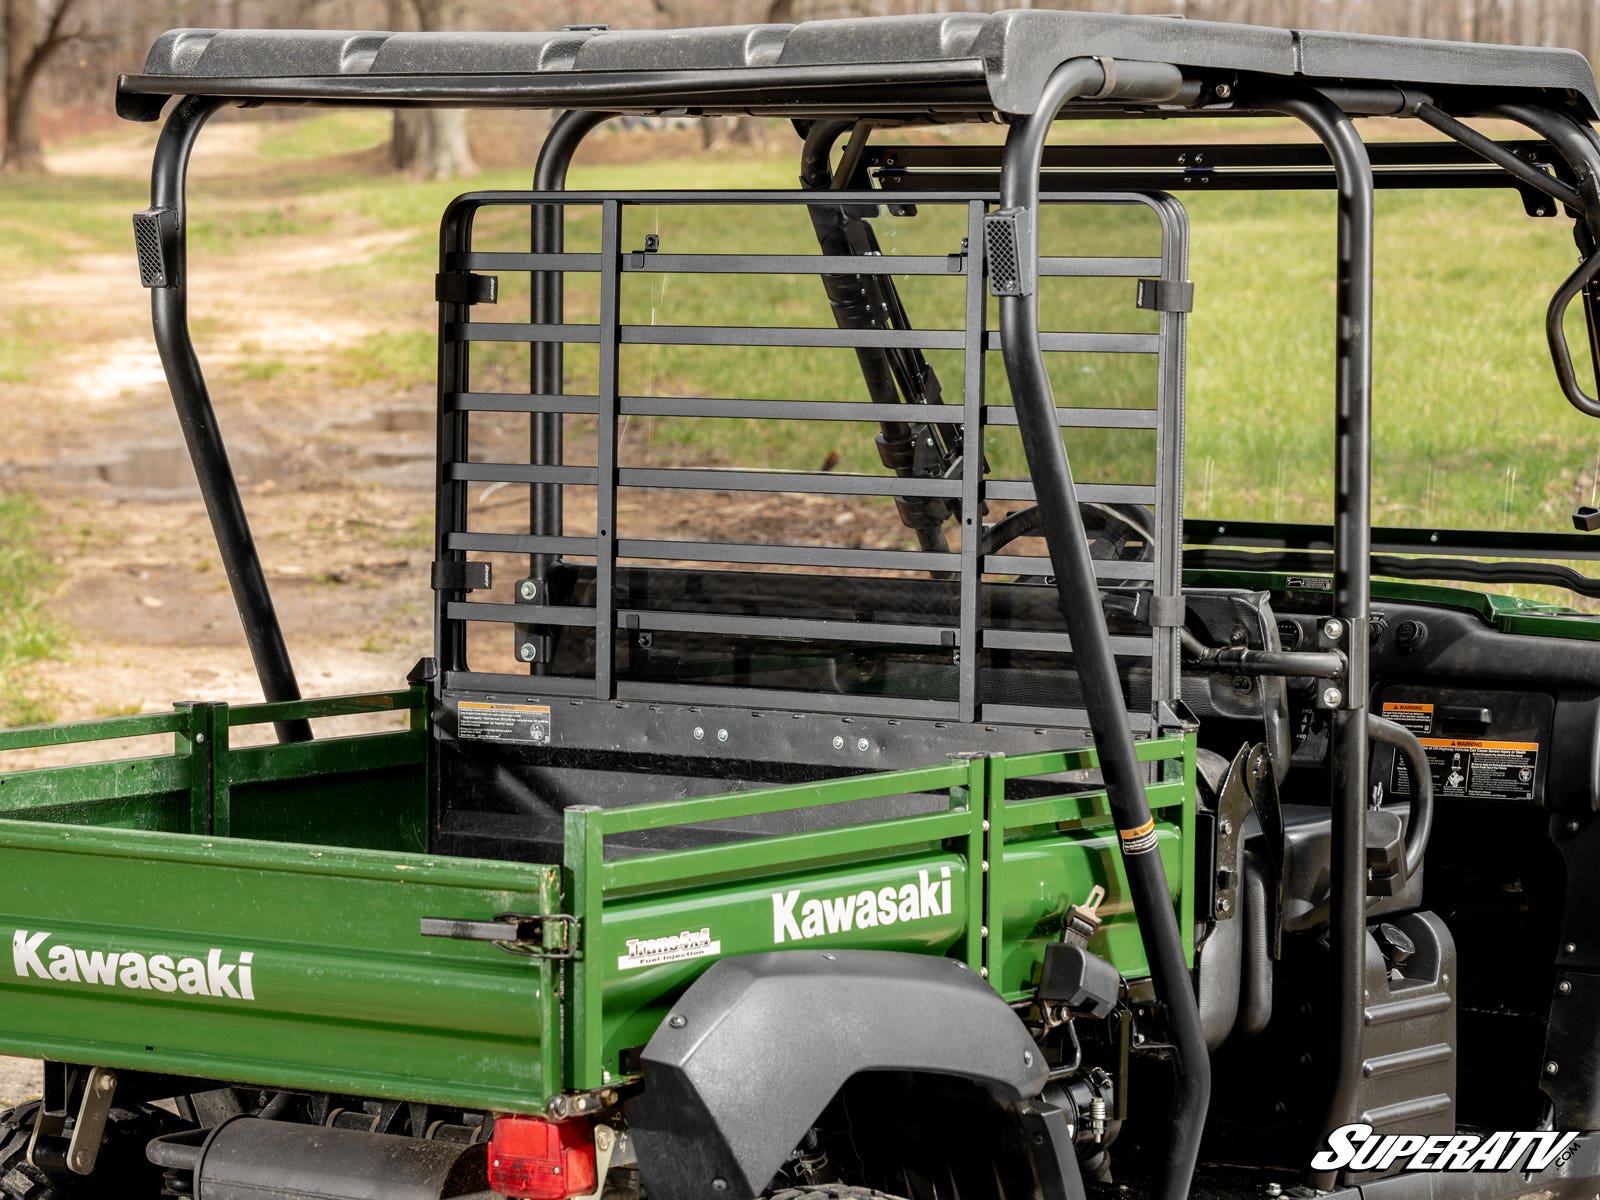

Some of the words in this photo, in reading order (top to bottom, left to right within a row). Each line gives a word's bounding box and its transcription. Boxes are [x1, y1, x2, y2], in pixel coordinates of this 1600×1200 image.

[772, 866, 952, 943] Kawasaki
[13, 929, 255, 1000] Kawasaki
[663, 950, 705, 961] Injection
